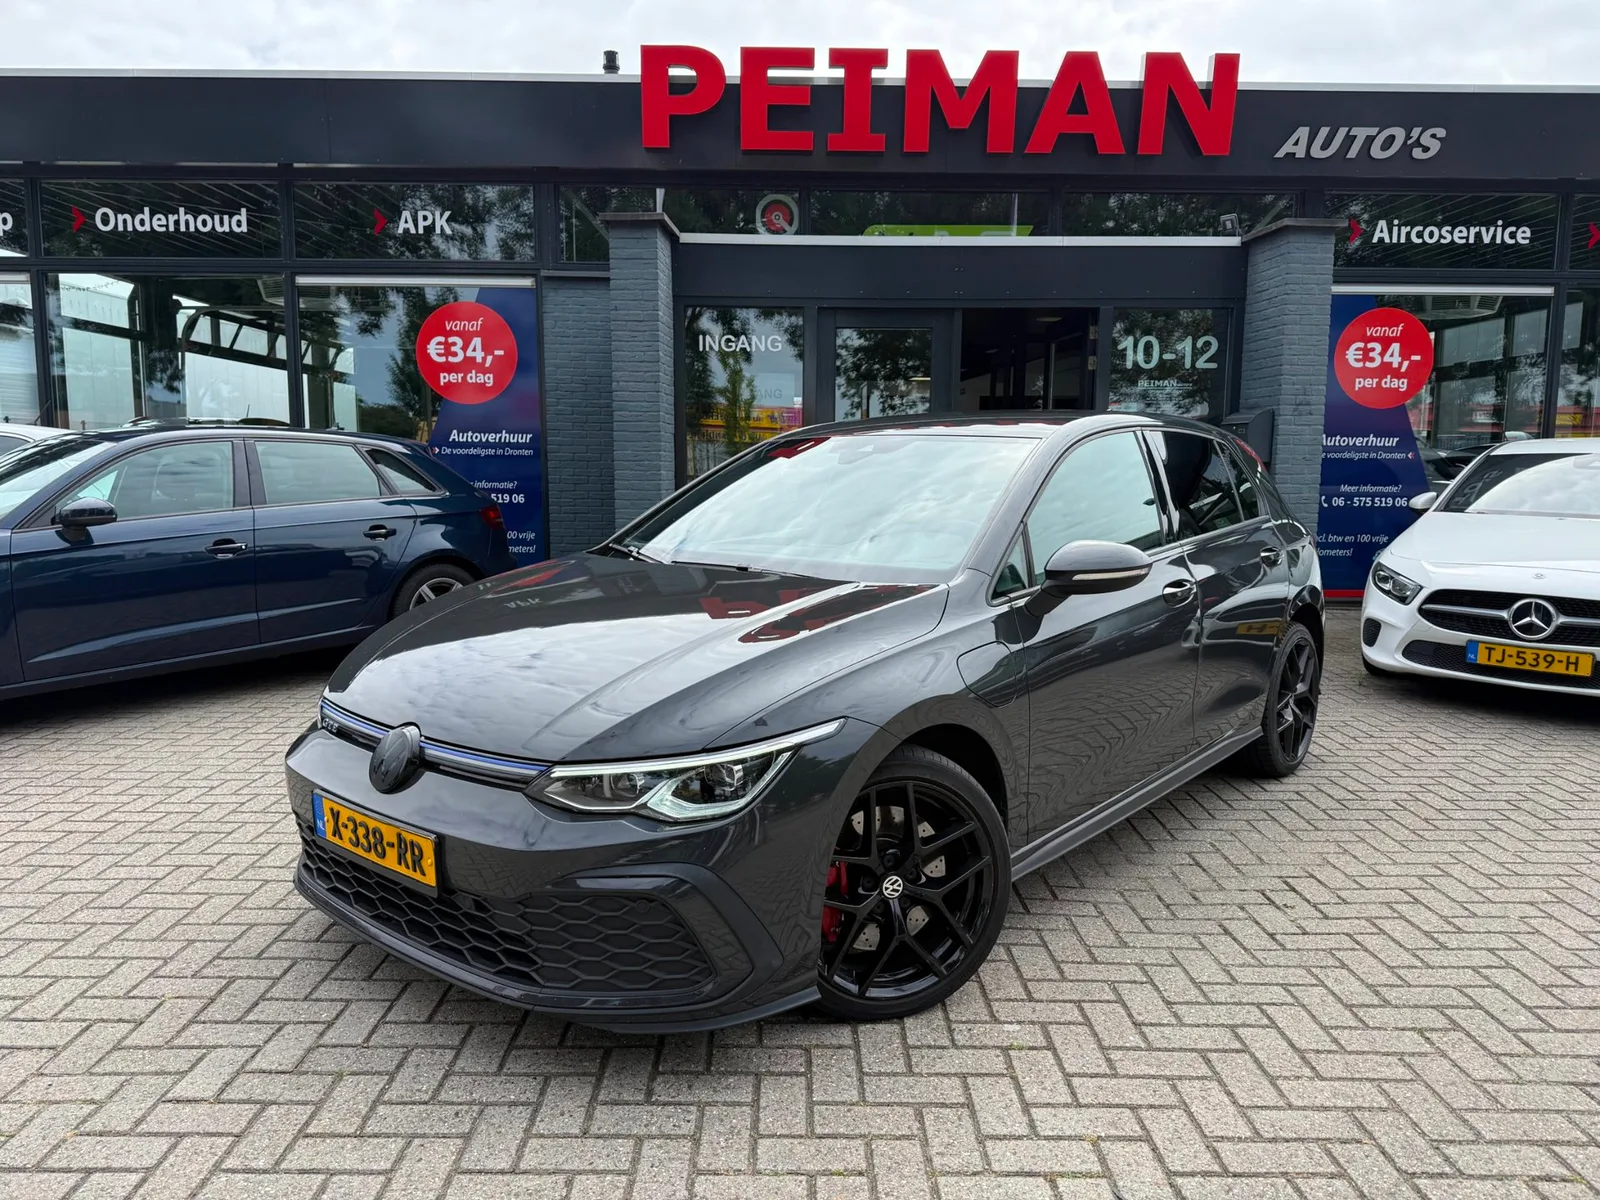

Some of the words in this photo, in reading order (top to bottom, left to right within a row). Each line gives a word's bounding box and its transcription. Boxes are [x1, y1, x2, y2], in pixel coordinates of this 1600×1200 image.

[640, 44, 1241, 155] PEIMAN
[1273, 126, 1447, 160] AUTO'S
[95, 206, 248, 233] Onderhoud
[397, 210, 453, 235] APK
[1372, 219, 1532, 245] Aircoservice
[445, 317, 484, 332] vanaf
[1366, 323, 1405, 337] vanaf
[426, 335, 505, 368] €34,-
[698, 334, 783, 352] INGANG
[1116, 335, 1219, 370] 10-12
[1345, 341, 1422, 373] €34,-
[440, 372, 463, 387] per
[466, 369, 494, 387] dag
[1354, 377, 1379, 391] per
[1381, 374, 1408, 392] dag
[448, 429, 533, 443] Autoverhuur
[441, 446, 452, 455] De
[452, 446, 496, 457] voordeligste
[496, 447, 503, 455] in
[504, 447, 534, 456] Dronten
[1326, 451, 1369, 461] voordeligste
[1369, 451, 1377, 459] in
[1377, 452, 1406, 460] Dronten
[474, 480, 518, 489] informatie?
[1340, 484, 1359, 493] Meer
[1359, 484, 1402, 493] informatie?
[511, 493, 525, 504] 06
[1332, 496, 1345, 507] 06
[1353, 496, 1374, 507] 575
[1374, 496, 1393, 507] 519
[1394, 497, 1408, 507] 06
[518, 530, 536, 542] vrije
[1327, 533, 1344, 543] btw
[1344, 535, 1355, 543] en
[1356, 534, 1372, 543] 100
[1371, 534, 1389, 545] vrije
[1484, 646, 1580, 672] TJ-539-H
[329, 807, 426, 877] X-338-RR
